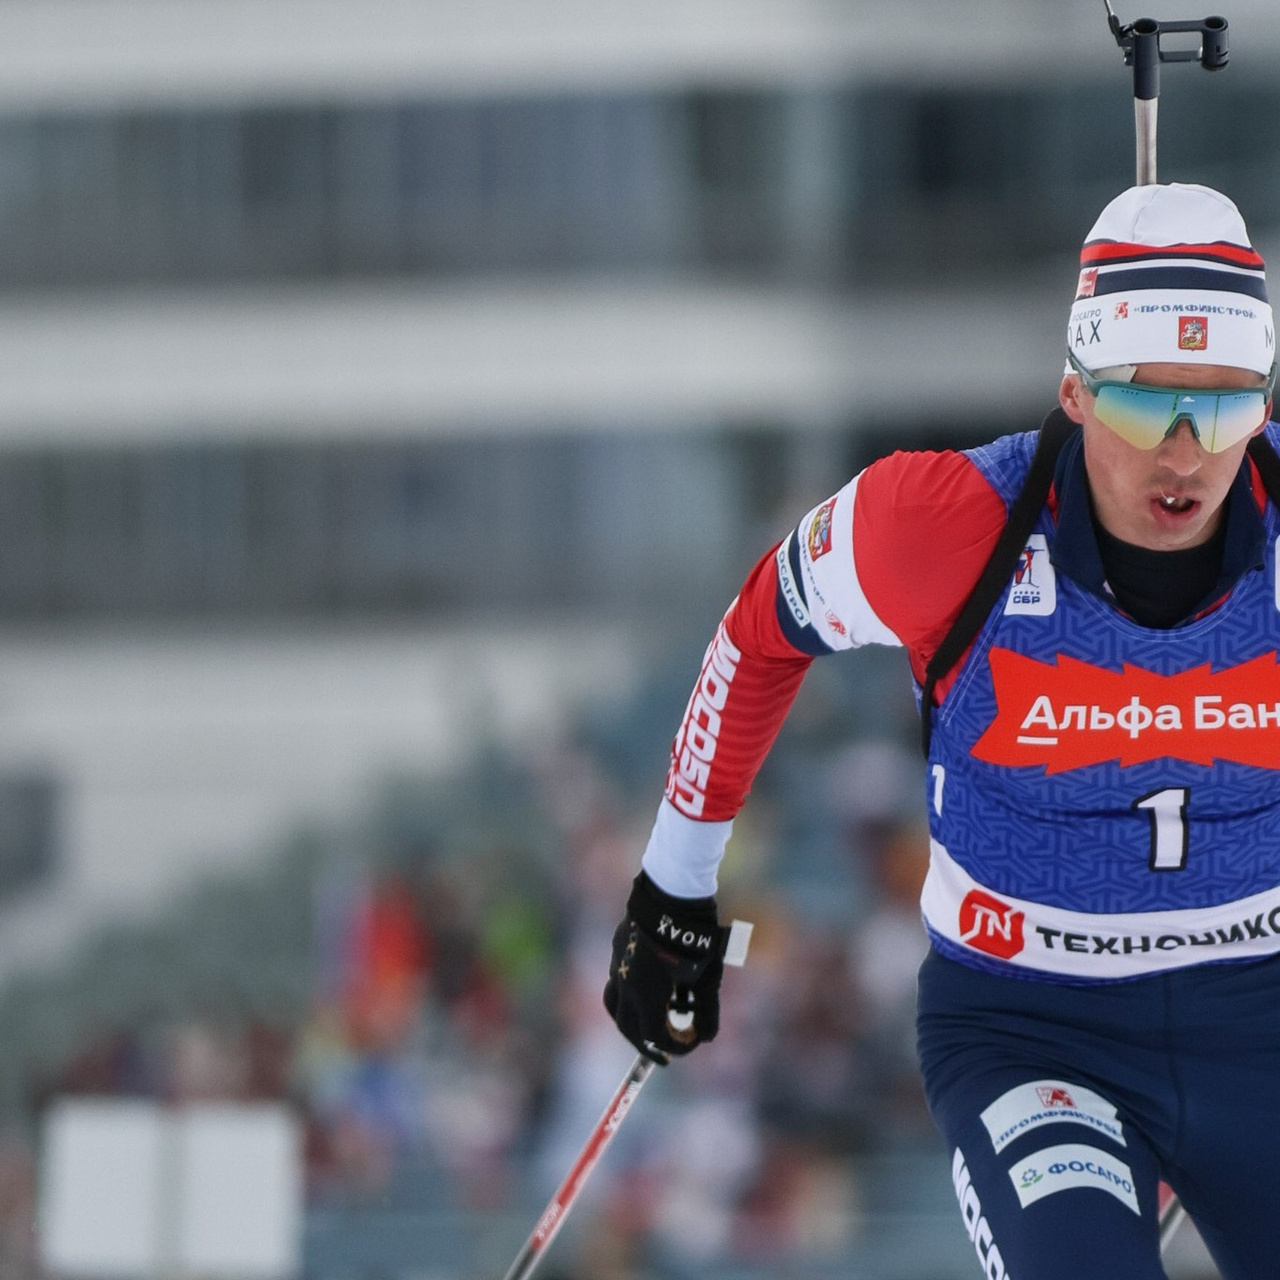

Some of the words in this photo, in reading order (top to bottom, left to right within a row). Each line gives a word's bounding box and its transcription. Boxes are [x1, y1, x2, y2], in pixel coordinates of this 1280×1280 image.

[1013, 595, 1041, 604] СБР
[1017, 695, 1182, 742] Альфа
[1132, 787, 1189, 870] 1
[657, 919, 712, 950] MOAX
[1048, 1161, 1132, 1193] ФОСАГРО
